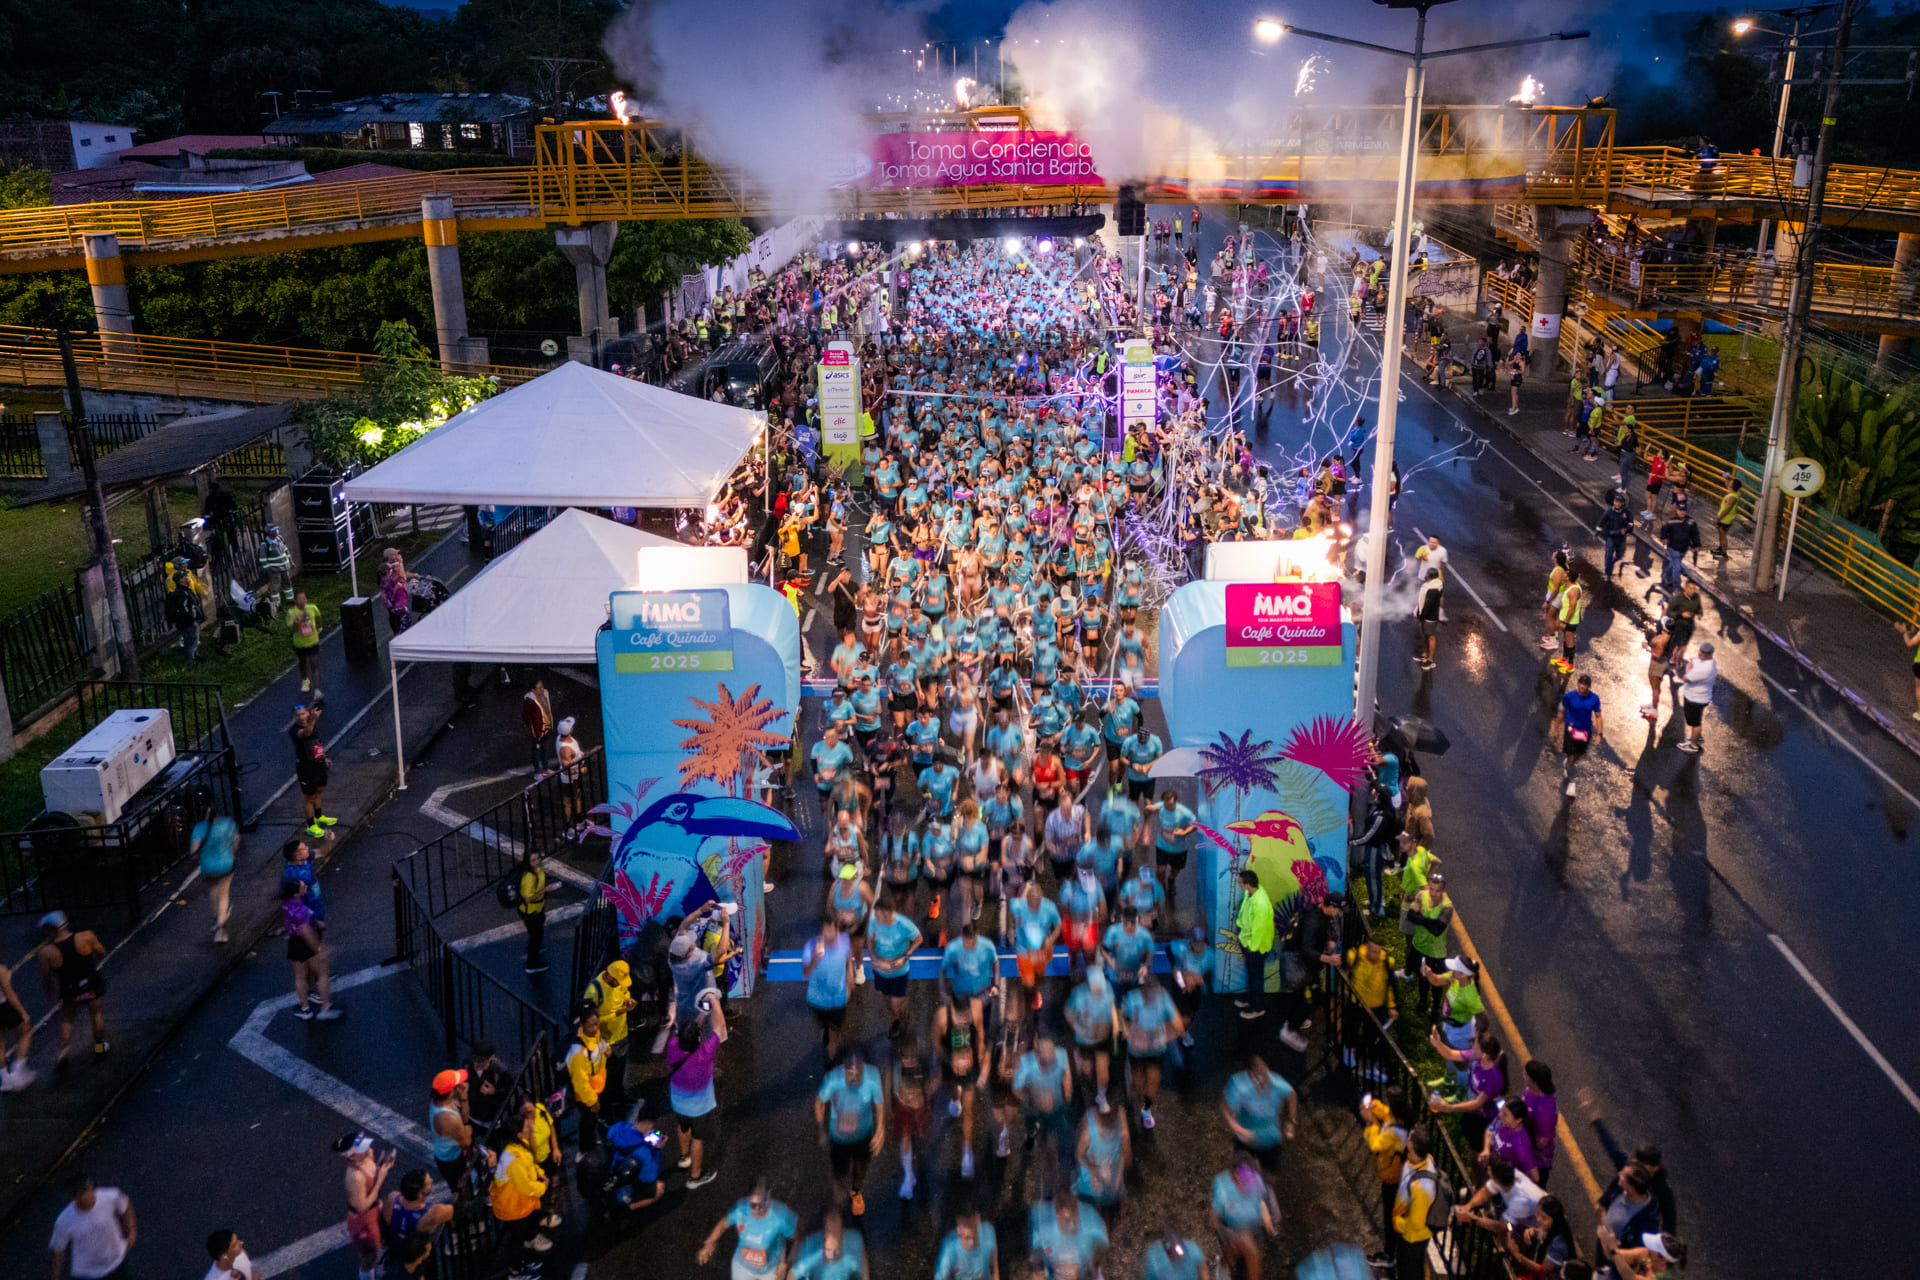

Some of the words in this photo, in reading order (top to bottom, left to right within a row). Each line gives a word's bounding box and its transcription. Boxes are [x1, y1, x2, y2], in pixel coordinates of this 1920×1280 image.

[907, 140, 966, 160] Toma
[972, 139, 1092, 159] Conciencia
[877, 161, 930, 179] Toma
[936, 160, 987, 182] Agua
[991, 159, 1044, 177] Santa
[641, 600, 701, 623] MMQ
[1253, 593, 1312, 616] MMQ
[630, 631, 663, 648] Café
[1241, 625, 1273, 642] Café
[650, 655, 701, 669] 2025
[1259, 649, 1309, 663] 2025
